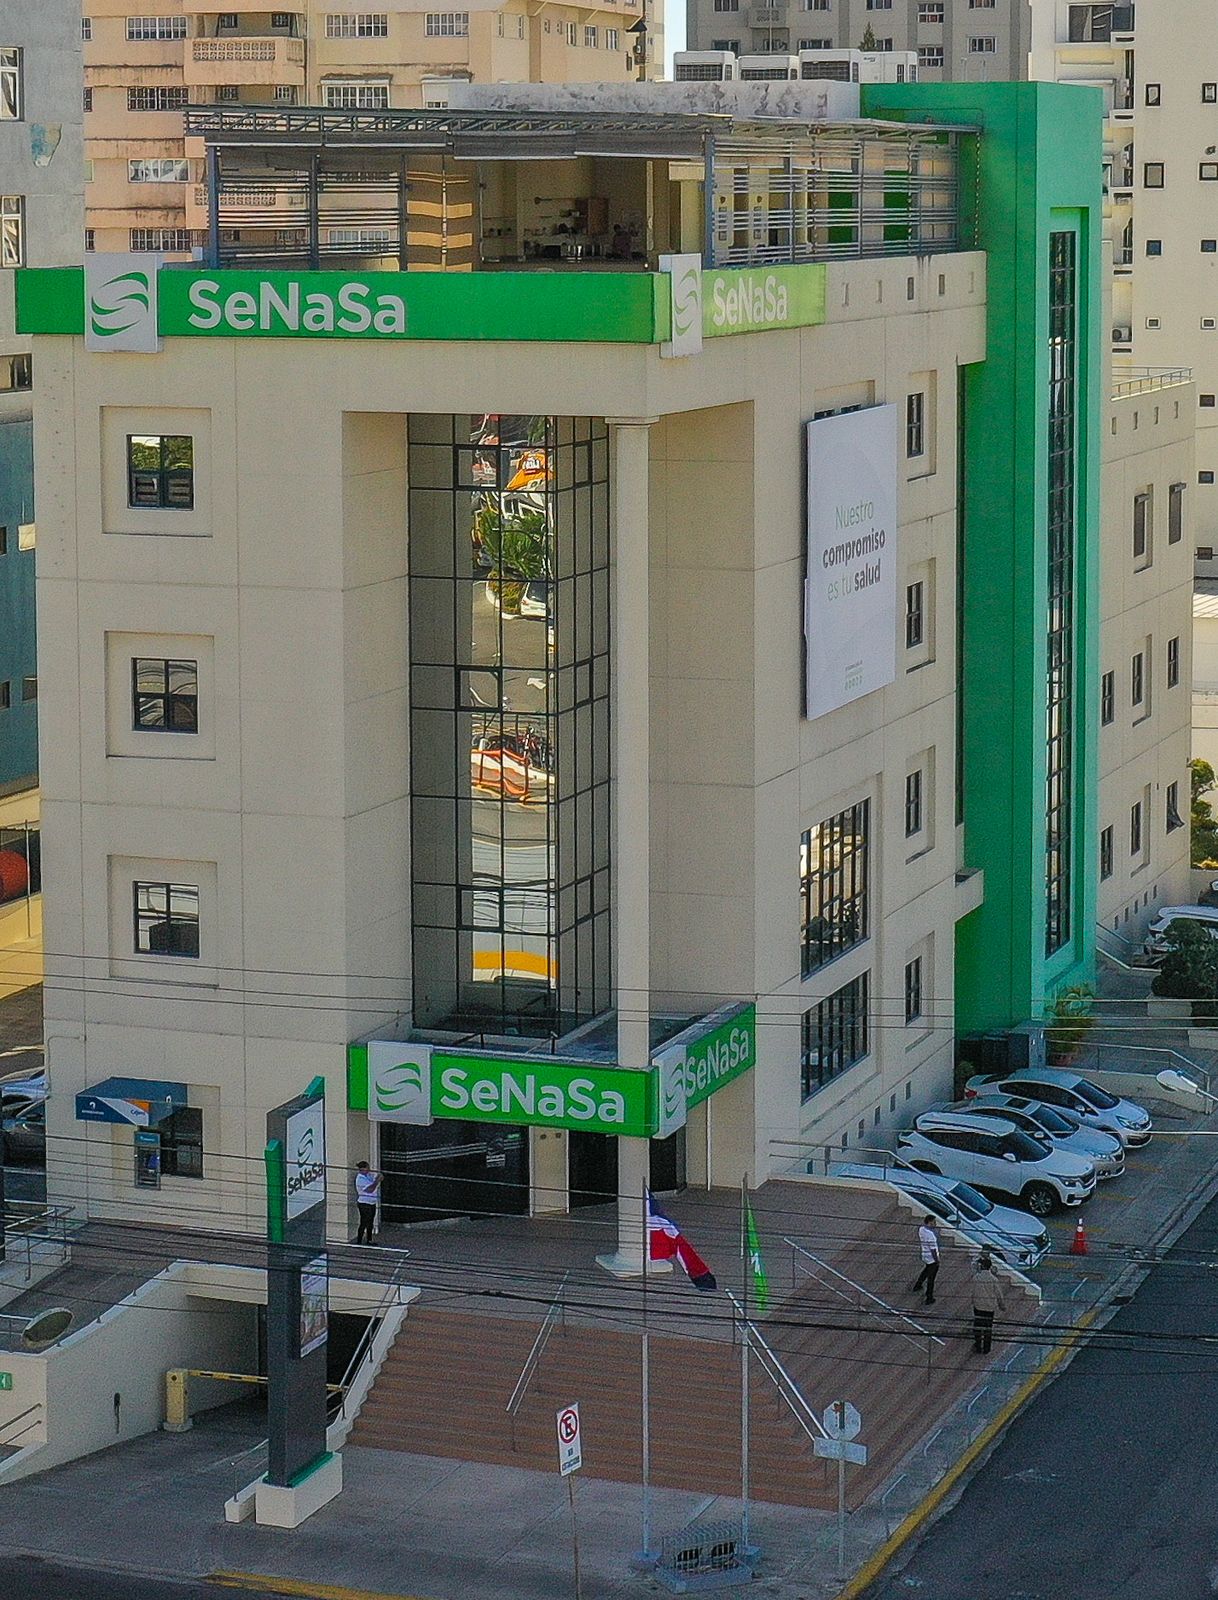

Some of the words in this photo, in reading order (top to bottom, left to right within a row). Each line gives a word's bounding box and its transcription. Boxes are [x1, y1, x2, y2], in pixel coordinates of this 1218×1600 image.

[188, 279, 405, 333] SeNaSa
[713, 275, 788, 326] SeNaSa
[835, 501, 874, 530] Nuestro
[823, 527, 886, 569] compromiso
[828, 582, 839, 601] es
[841, 573, 852, 596] tu
[854, 558, 881, 592] salud
[685, 1027, 749, 1098] SeNaSa
[440, 1068, 625, 1123] SeNaSa
[288, 1162, 324, 1196] SeNaSa
